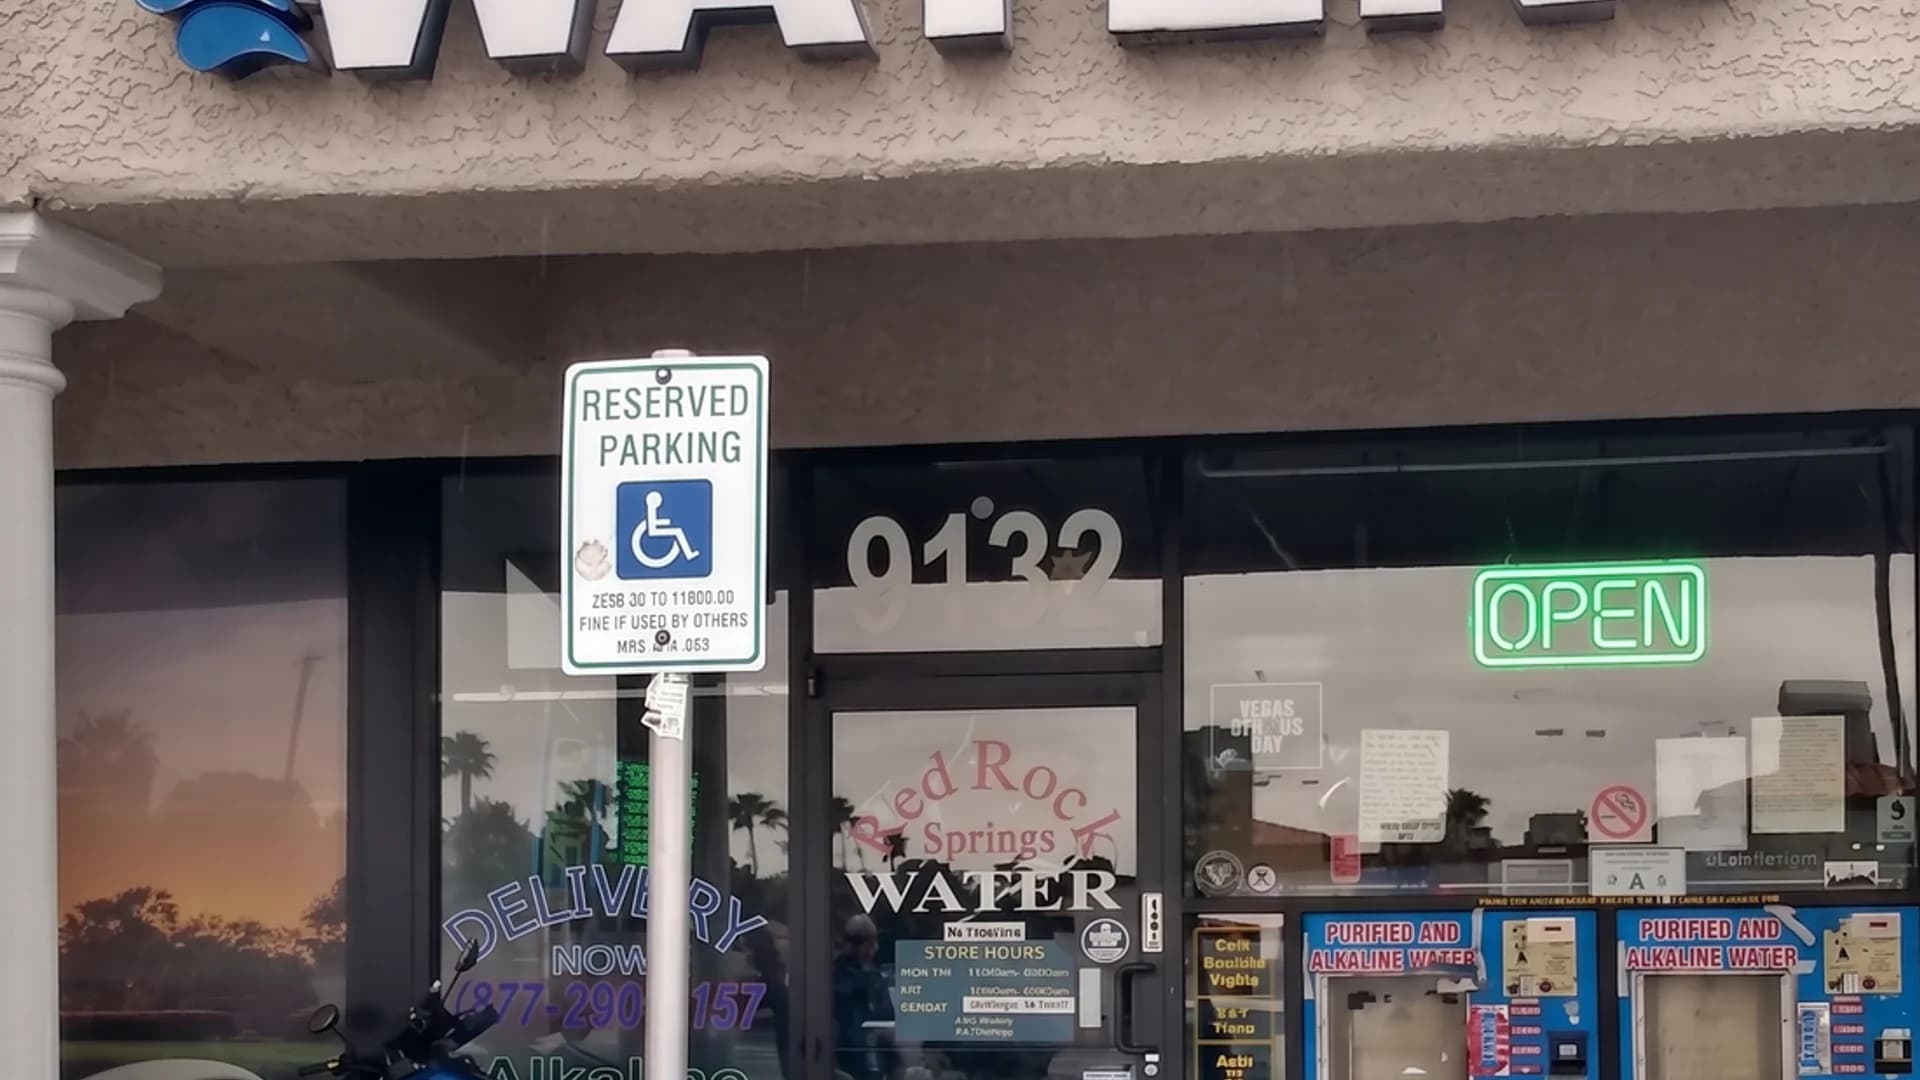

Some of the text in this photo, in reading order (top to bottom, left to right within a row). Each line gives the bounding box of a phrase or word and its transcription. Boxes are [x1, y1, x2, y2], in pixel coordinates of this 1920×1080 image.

[582, 384, 749, 422] RESERVED
[600, 430, 742, 467] PARKING
[847, 508, 1123, 633] 9132
[650, 591, 668, 607] TO
[579, 612, 748, 631] FINE IF USED BY OTHERS
[1489, 579, 1689, 650] OPEN
[1240, 699, 1294, 718] VEGAS
[1252, 735, 1282, 753] DAY
[852, 739, 1121, 860] Red Rock
[923, 821, 1056, 862] Springs
[844, 870, 1122, 915] WATER
[1326, 921, 1461, 944] PURIFIED AND
[1640, 918, 1780, 940] PURIFIED AND
[552, 944, 648, 976] NOW
[924, 945, 1045, 960] STORE HOURS
[1310, 950, 1478, 971] ALKALINE WATER
[1627, 947, 1799, 968] ALKALINE WATER
